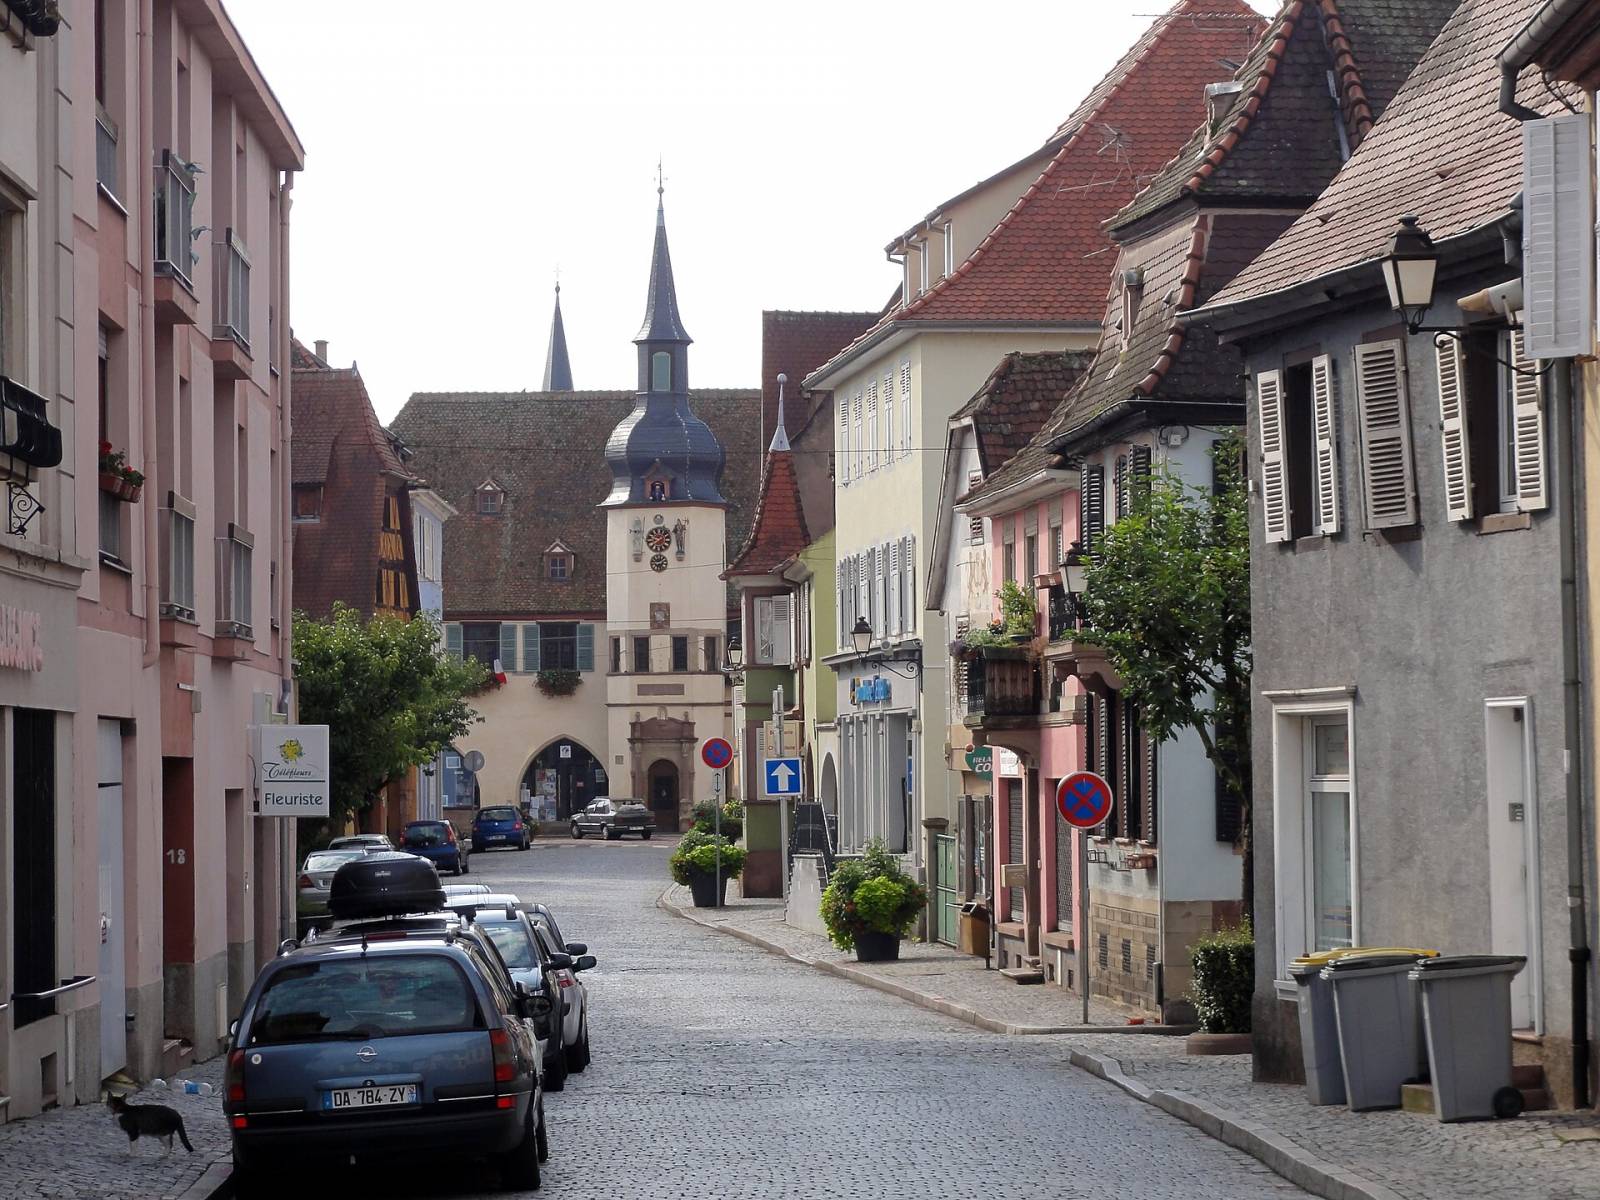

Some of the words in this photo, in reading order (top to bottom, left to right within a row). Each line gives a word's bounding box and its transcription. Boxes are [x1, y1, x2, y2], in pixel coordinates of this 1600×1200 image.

[975, 763, 993, 773] CO
[264, 792, 323, 806] Fleuriste
[166, 848, 186, 865] 18
